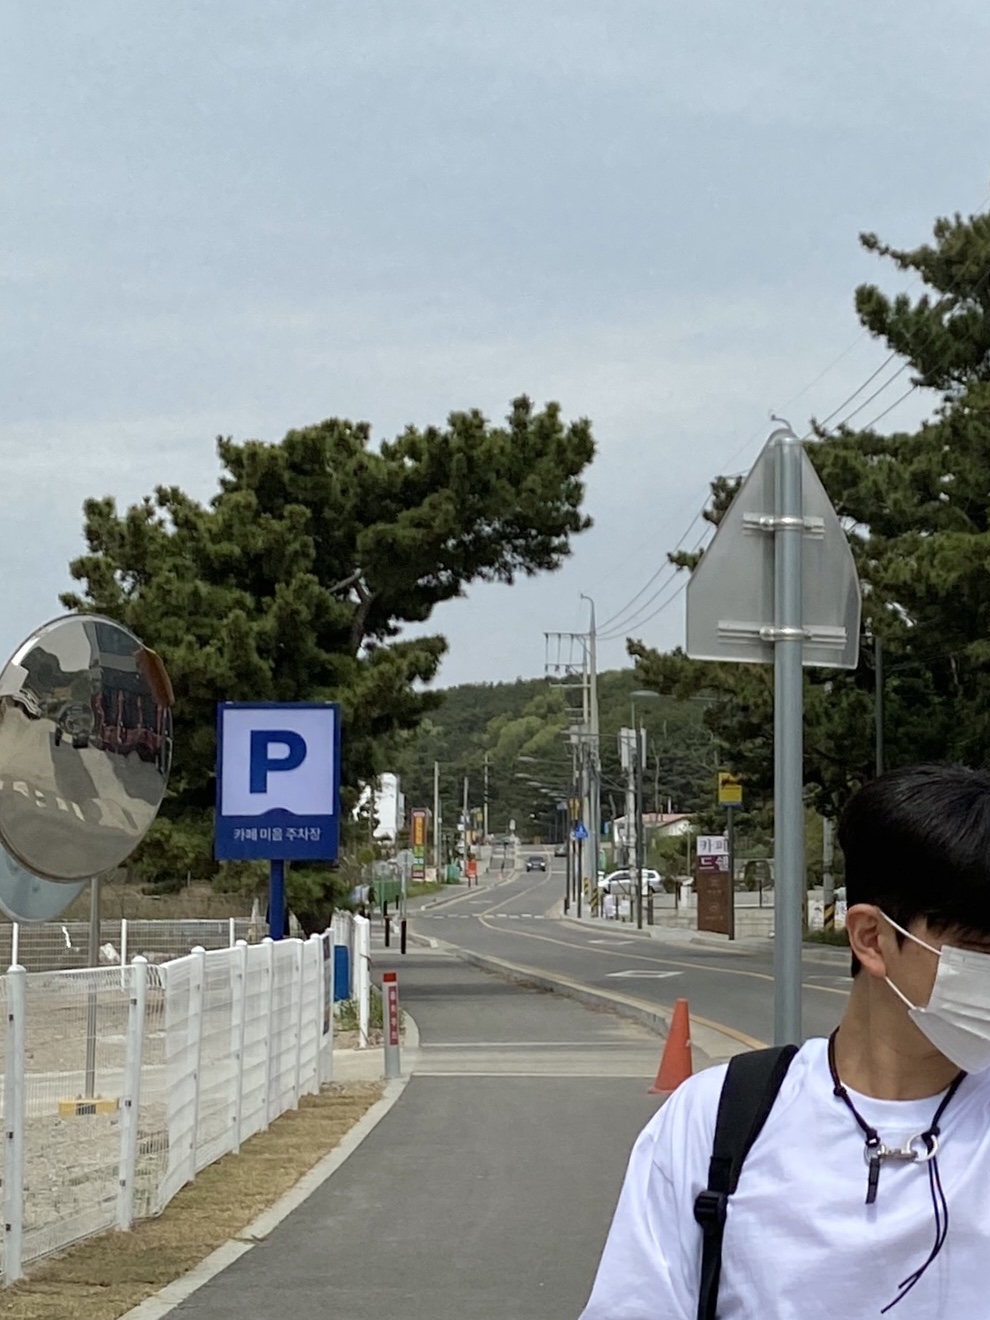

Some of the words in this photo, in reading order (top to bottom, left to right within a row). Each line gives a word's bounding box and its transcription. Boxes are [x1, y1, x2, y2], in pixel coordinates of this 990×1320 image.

[249, 729, 308, 794] P
[233, 827, 258, 842] 카페
[285, 827, 321, 842] 주차장
